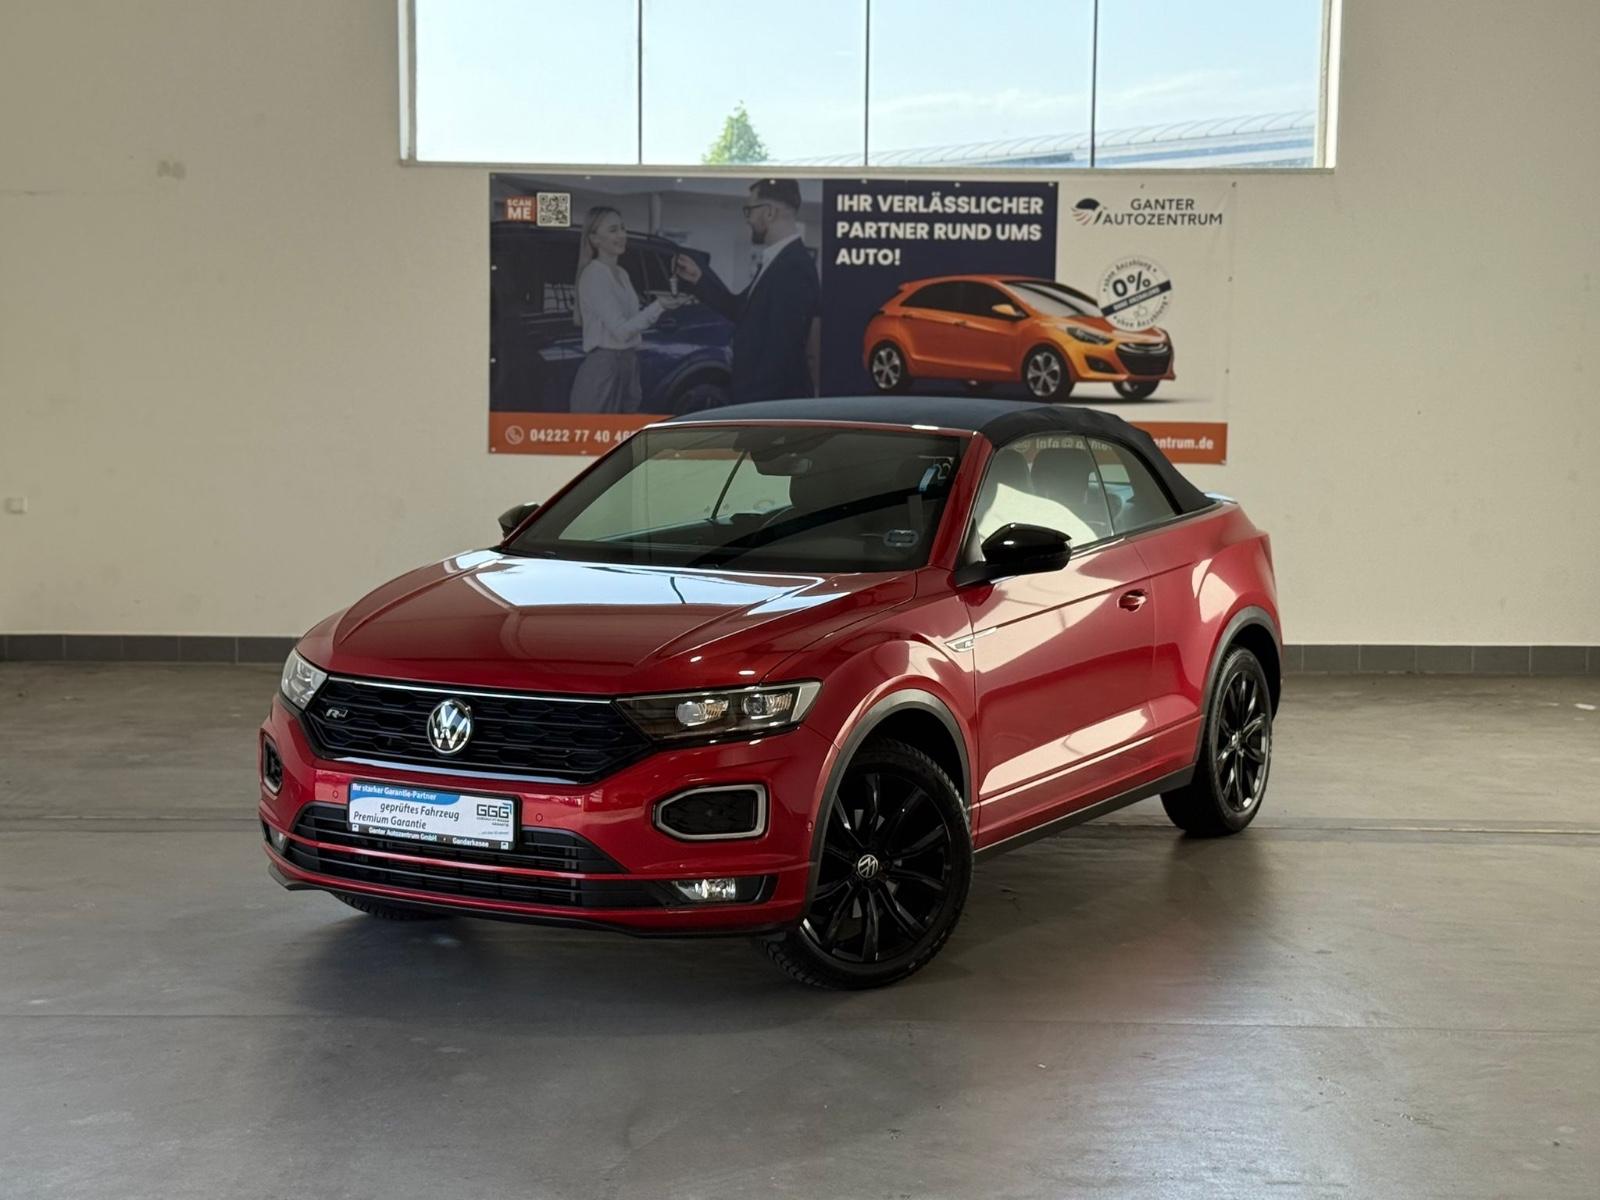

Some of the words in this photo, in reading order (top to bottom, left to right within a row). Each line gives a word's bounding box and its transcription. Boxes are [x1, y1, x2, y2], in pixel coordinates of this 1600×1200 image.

[507, 198, 532, 206] SCAN
[837, 194, 872, 212] IHR
[877, 191, 1044, 215] VERLÄSSLICHER
[1130, 198, 1195, 211] GANTER
[507, 207, 531, 220] ME
[1102, 213, 1223, 226] AUTOZENTRUM
[836, 221, 929, 240] PARTNER
[934, 223, 992, 241] RUND
[996, 224, 1042, 241] UMS
[835, 248, 901, 266] AUTO!
[1112, 271, 1151, 298] 0%
[530, 428, 570, 442] 04222
[574, 429, 590, 442] 77
[594, 429, 609, 443] 40
[352, 783, 361, 791] Ihr
[362, 784, 383, 794] starker
[384, 787, 437, 800] Garantie-Partner
[380, 802, 419, 815] geprüftes
[420, 805, 460, 822] Fahrzeug
[476, 803, 510, 819] GGG
[353, 811, 389, 824] Premium
[390, 816, 427, 830] Garantie
[386, 828, 420, 840] Autozentrum
[420, 833, 438, 842] GmbH
